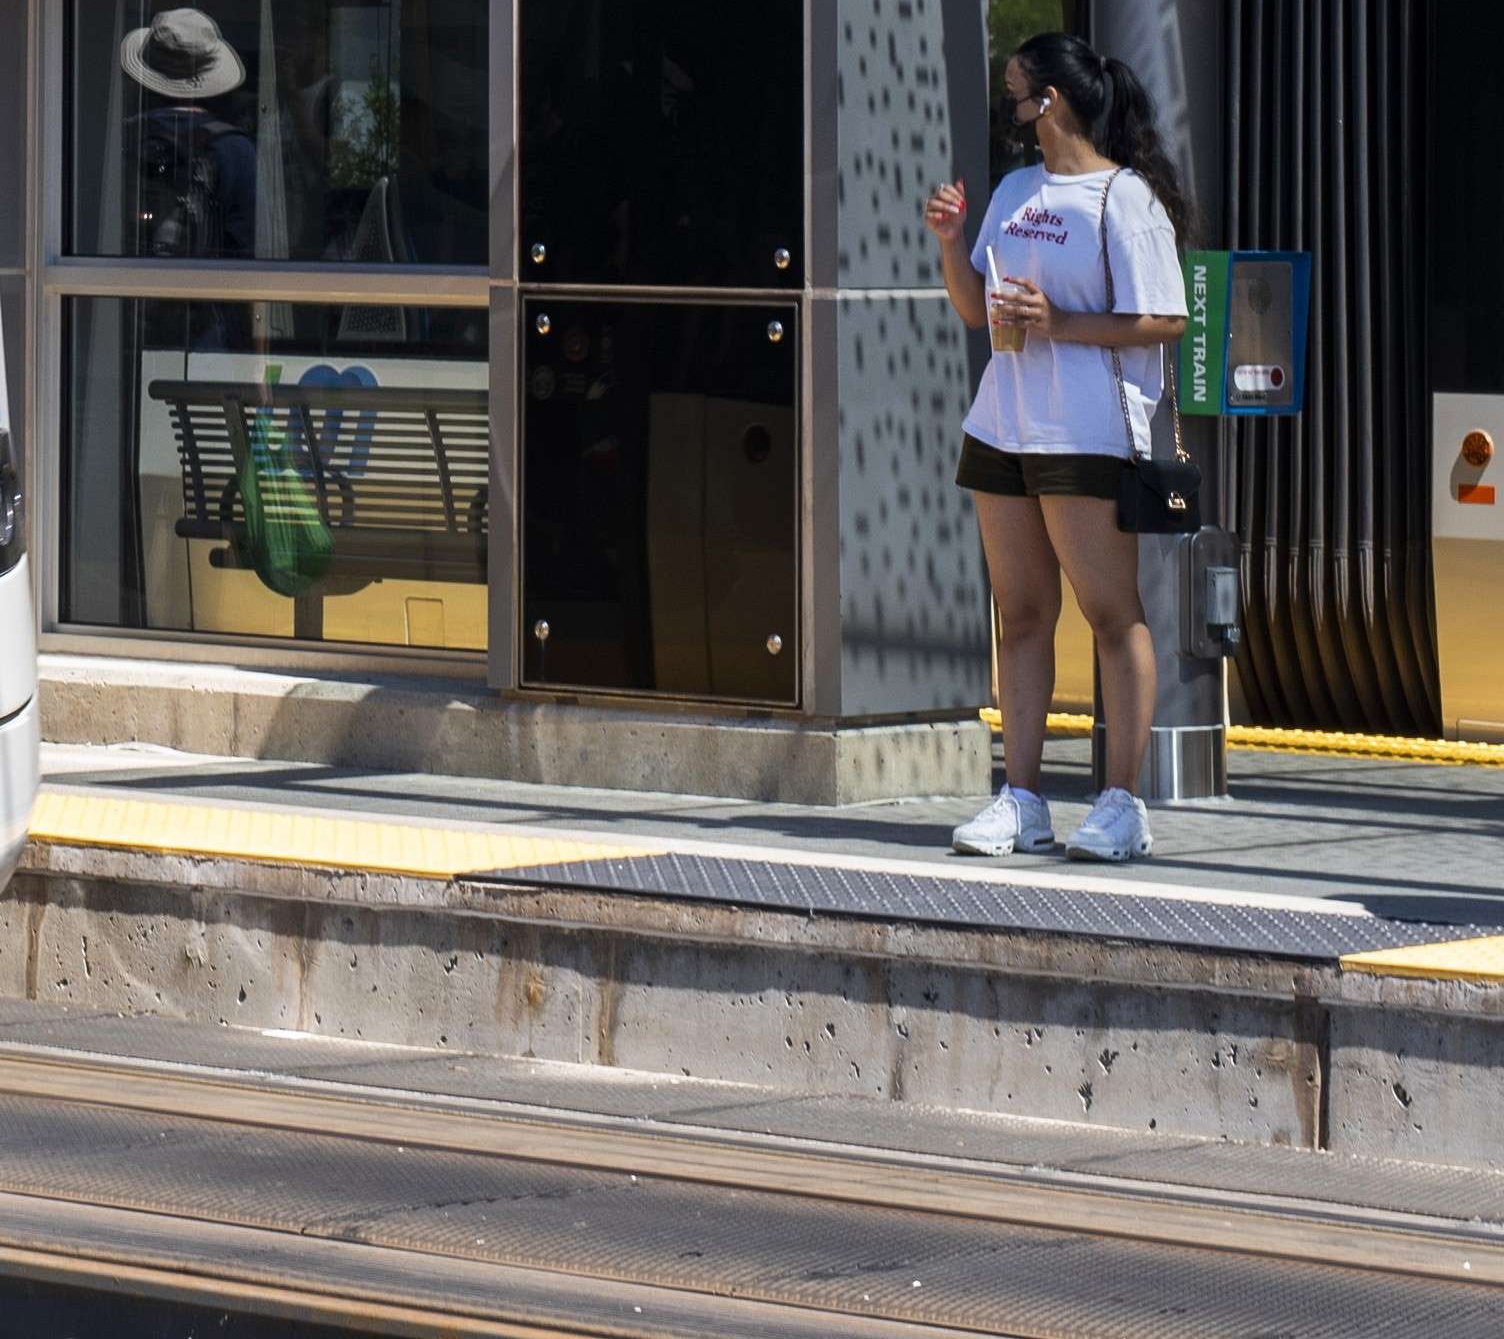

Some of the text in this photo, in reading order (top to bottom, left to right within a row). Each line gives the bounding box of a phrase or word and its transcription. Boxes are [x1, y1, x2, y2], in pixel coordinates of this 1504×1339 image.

[1022, 206, 1064, 227] Rights
[1004, 222, 1068, 245] Reserved
[1193, 265, 1207, 402] NEXT TRAIN
